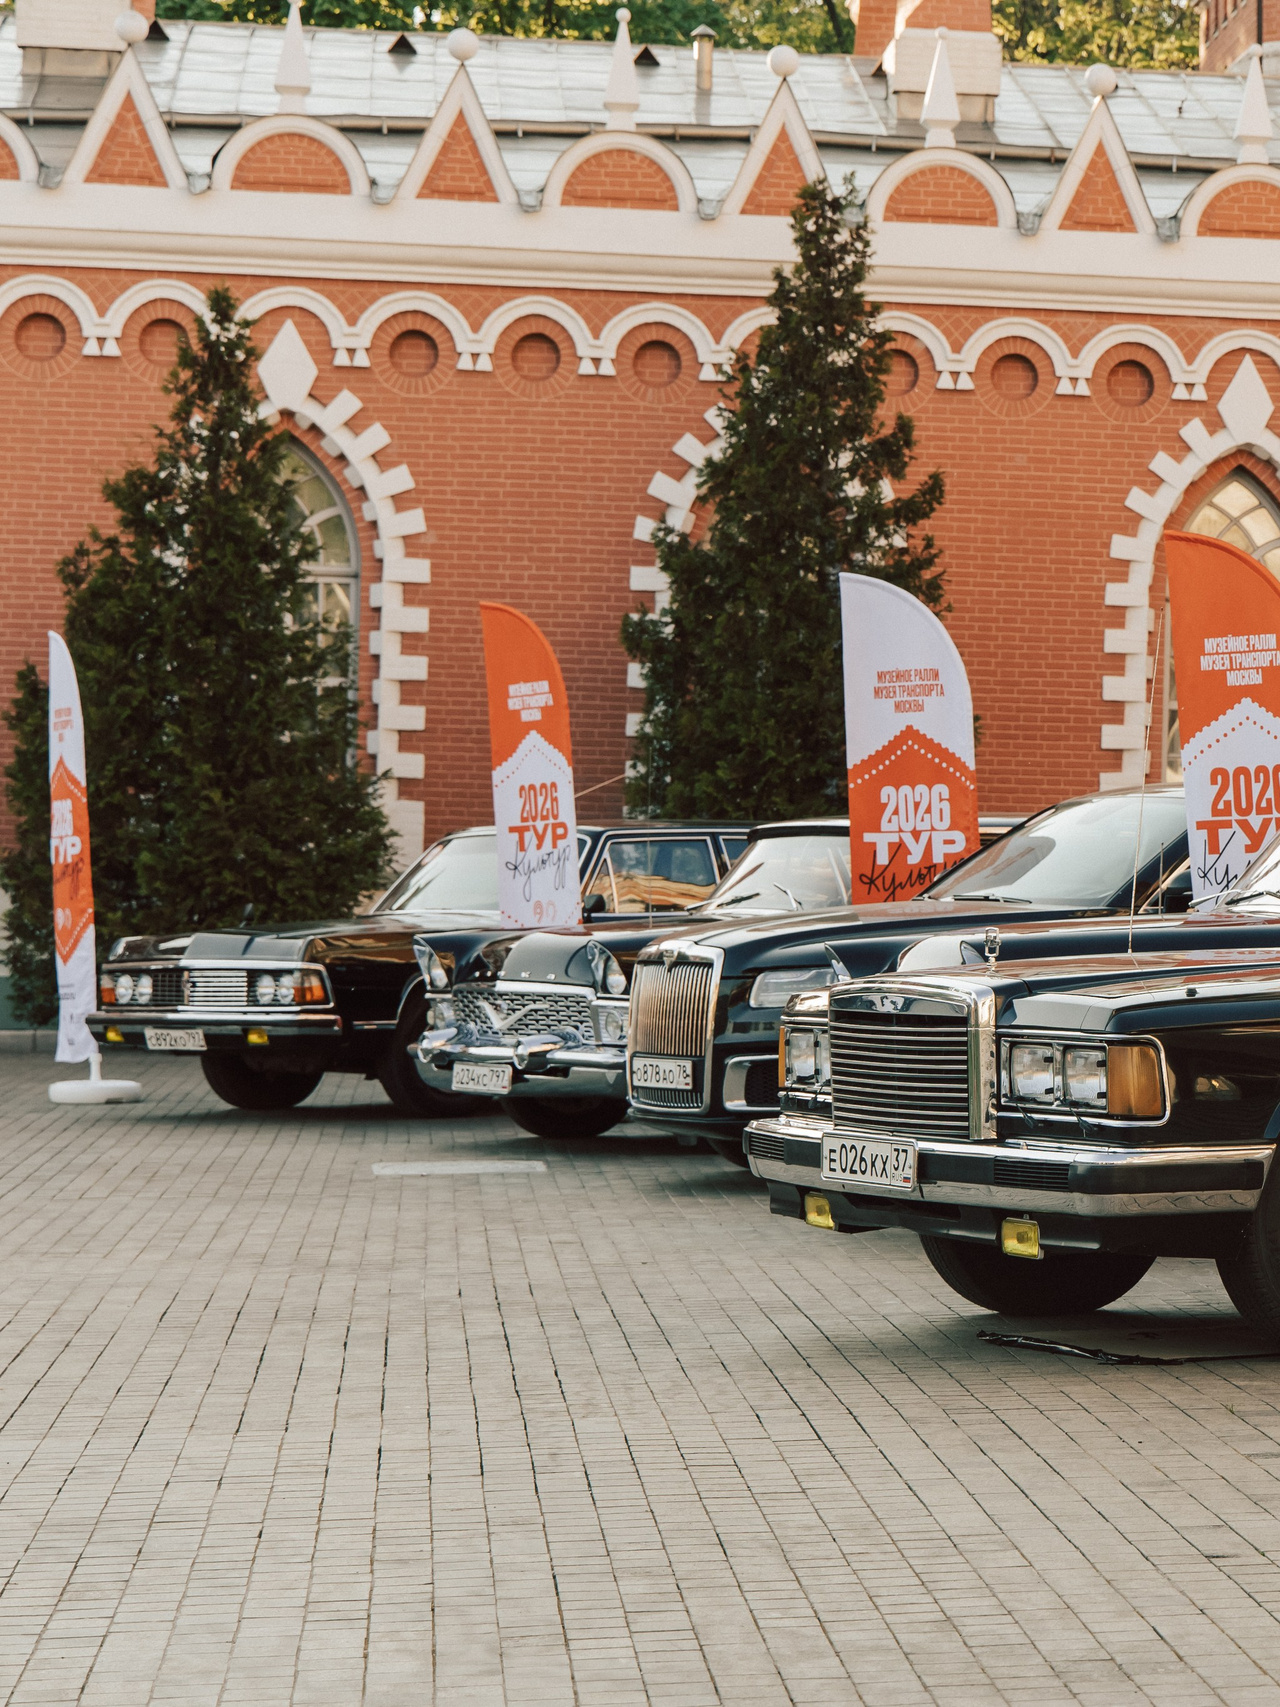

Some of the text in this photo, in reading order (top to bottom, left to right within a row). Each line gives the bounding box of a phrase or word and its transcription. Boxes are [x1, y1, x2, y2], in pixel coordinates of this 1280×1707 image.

[1204, 634, 1277, 654] МУЗЕЙНОЕ РАЛЛИ
[1200, 654, 1230, 671] МУЗЕЯ
[877, 667, 940, 684] МУЗЕЙНОЕ РАЛЛИ
[1226, 668, 1263, 687] МОСКВЫ
[874, 684, 945, 699] МУЗЕЯ ТРАНСПОРТА
[894, 699, 925, 713] МОСКВЫ
[519, 782, 559, 823] 2026
[880, 784, 951, 832] 2026
[508, 821, 569, 853] ТУР
[863, 830, 967, 865] ТУР
[505, 835, 571, 902] Культур
[893, 1147, 909, 1172] 37
